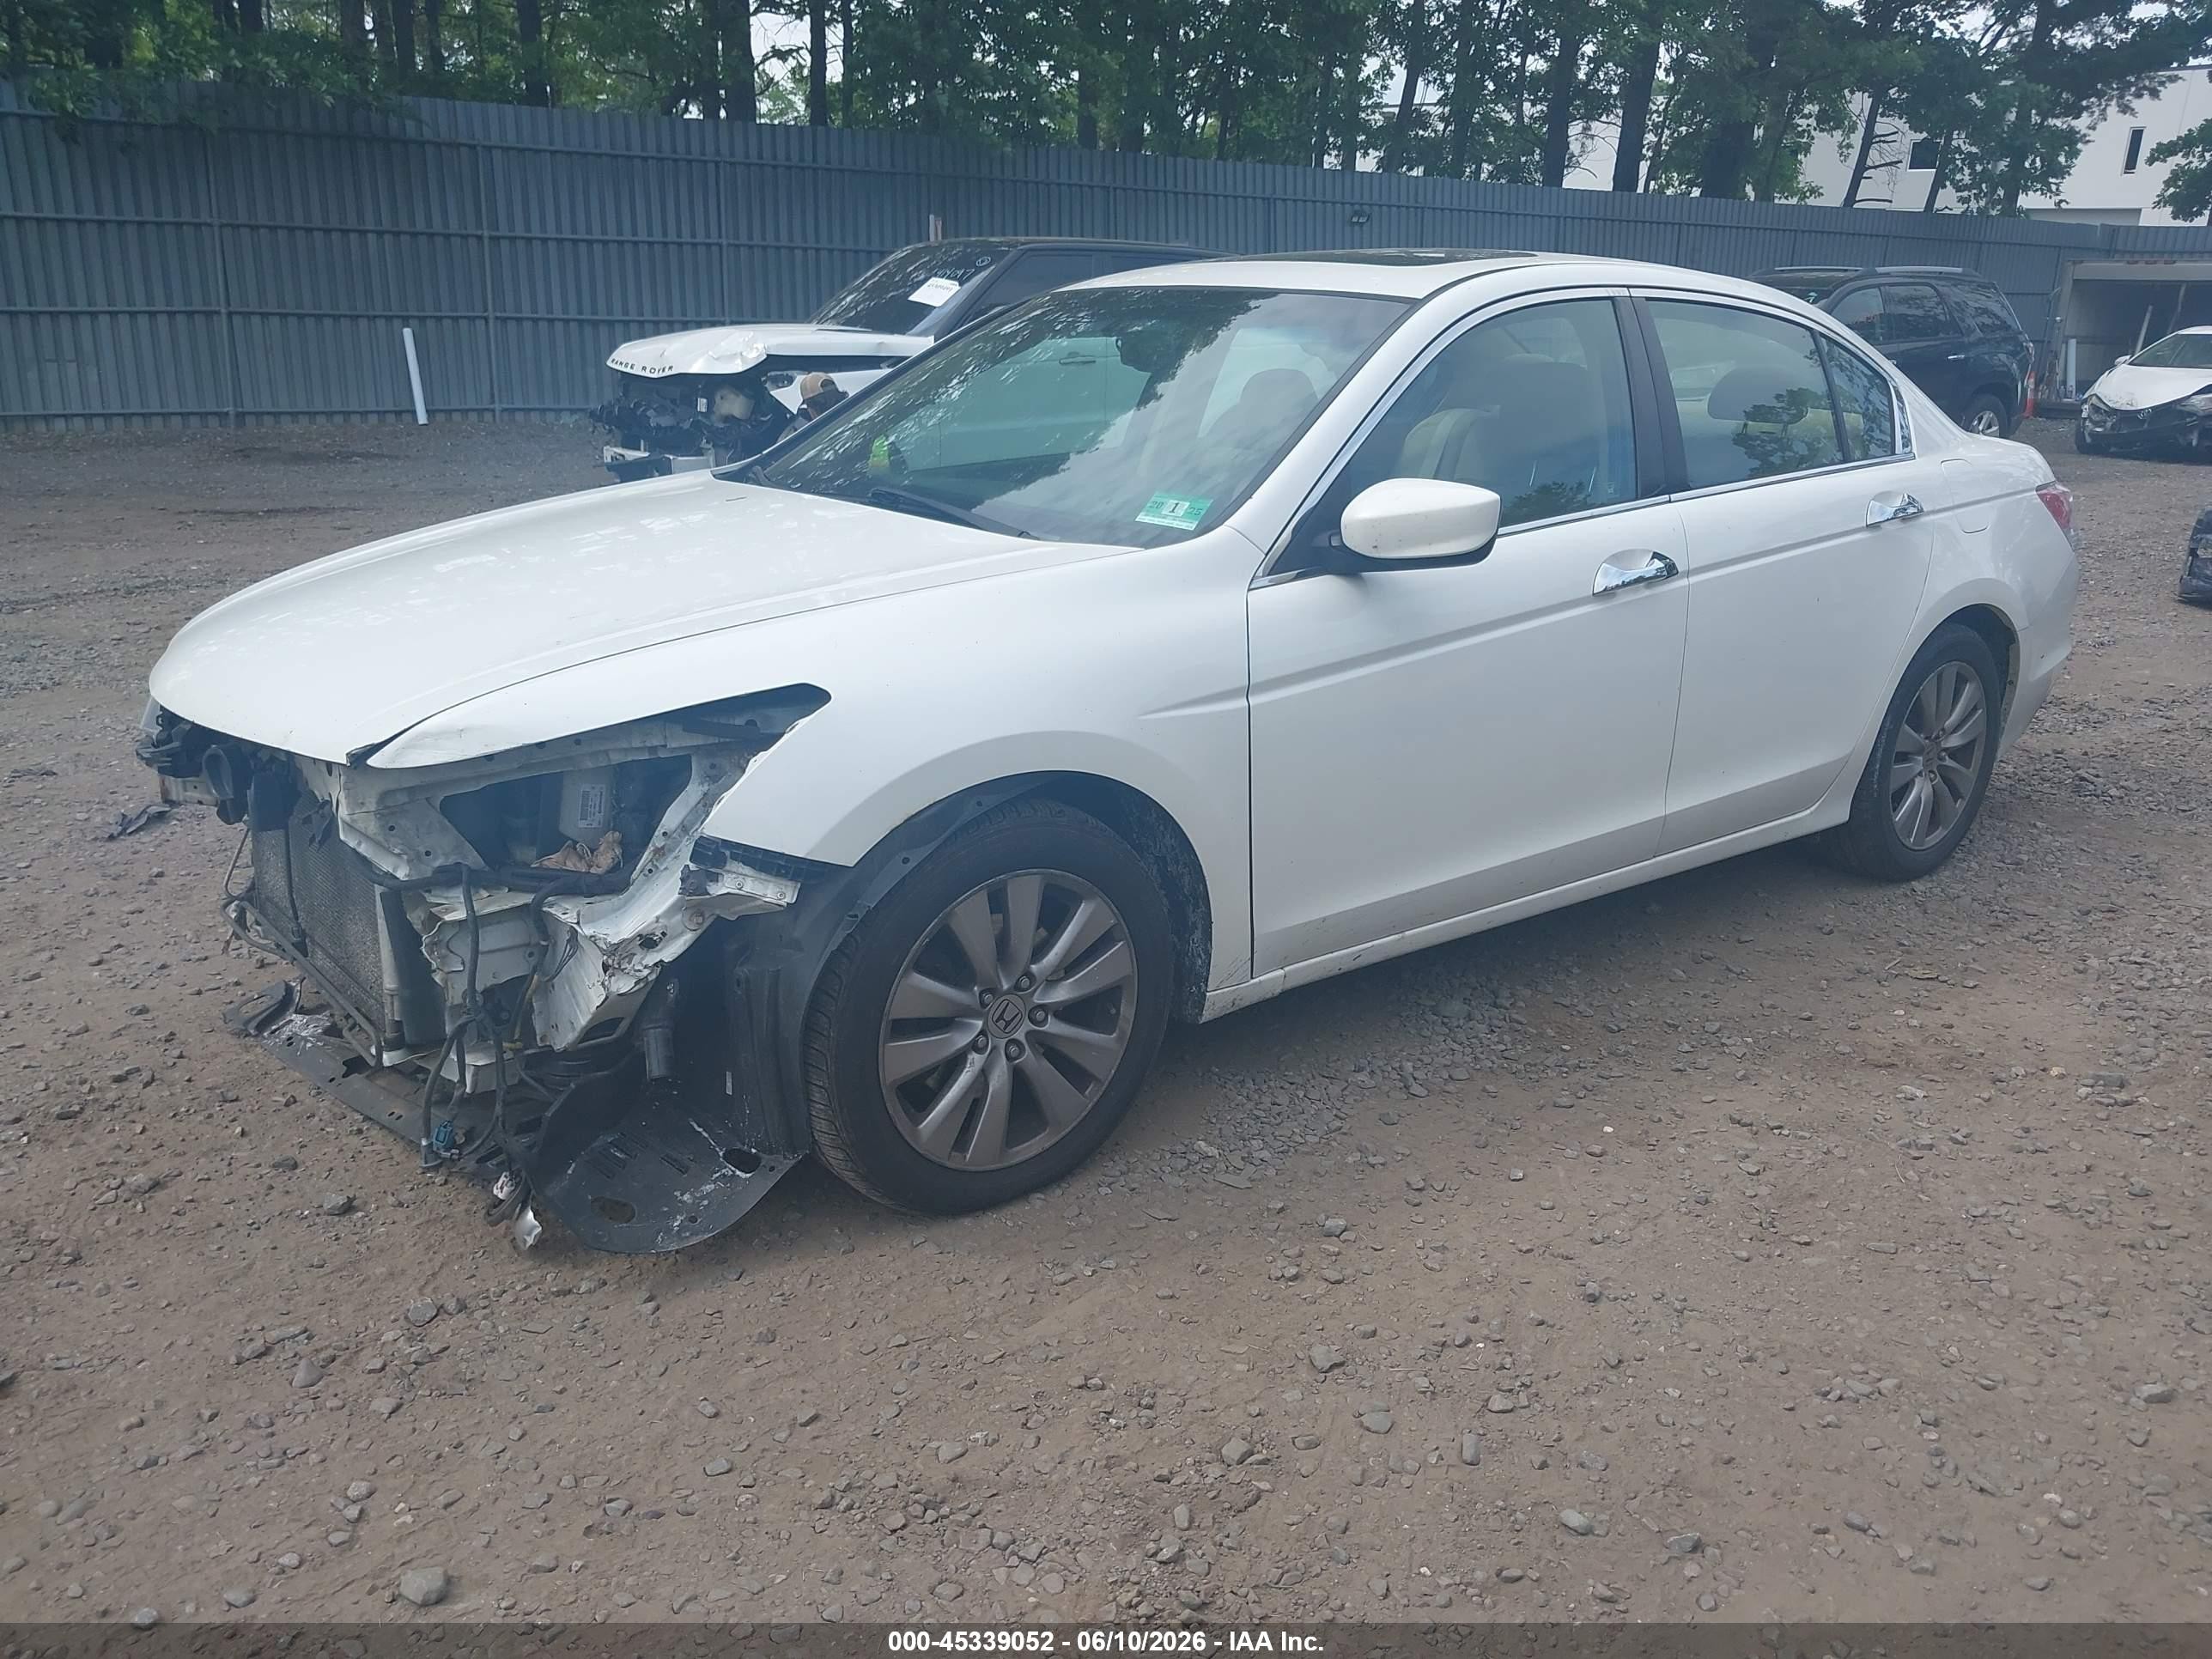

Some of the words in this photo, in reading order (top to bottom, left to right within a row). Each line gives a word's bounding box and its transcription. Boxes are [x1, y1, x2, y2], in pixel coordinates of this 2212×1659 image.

[611, 358, 635, 370] RANGE
[641, 366, 673, 374] ROVER
[1149, 501, 1164, 510] 20
[1169, 501, 1180, 514] 1
[1187, 507, 1203, 516] 25
